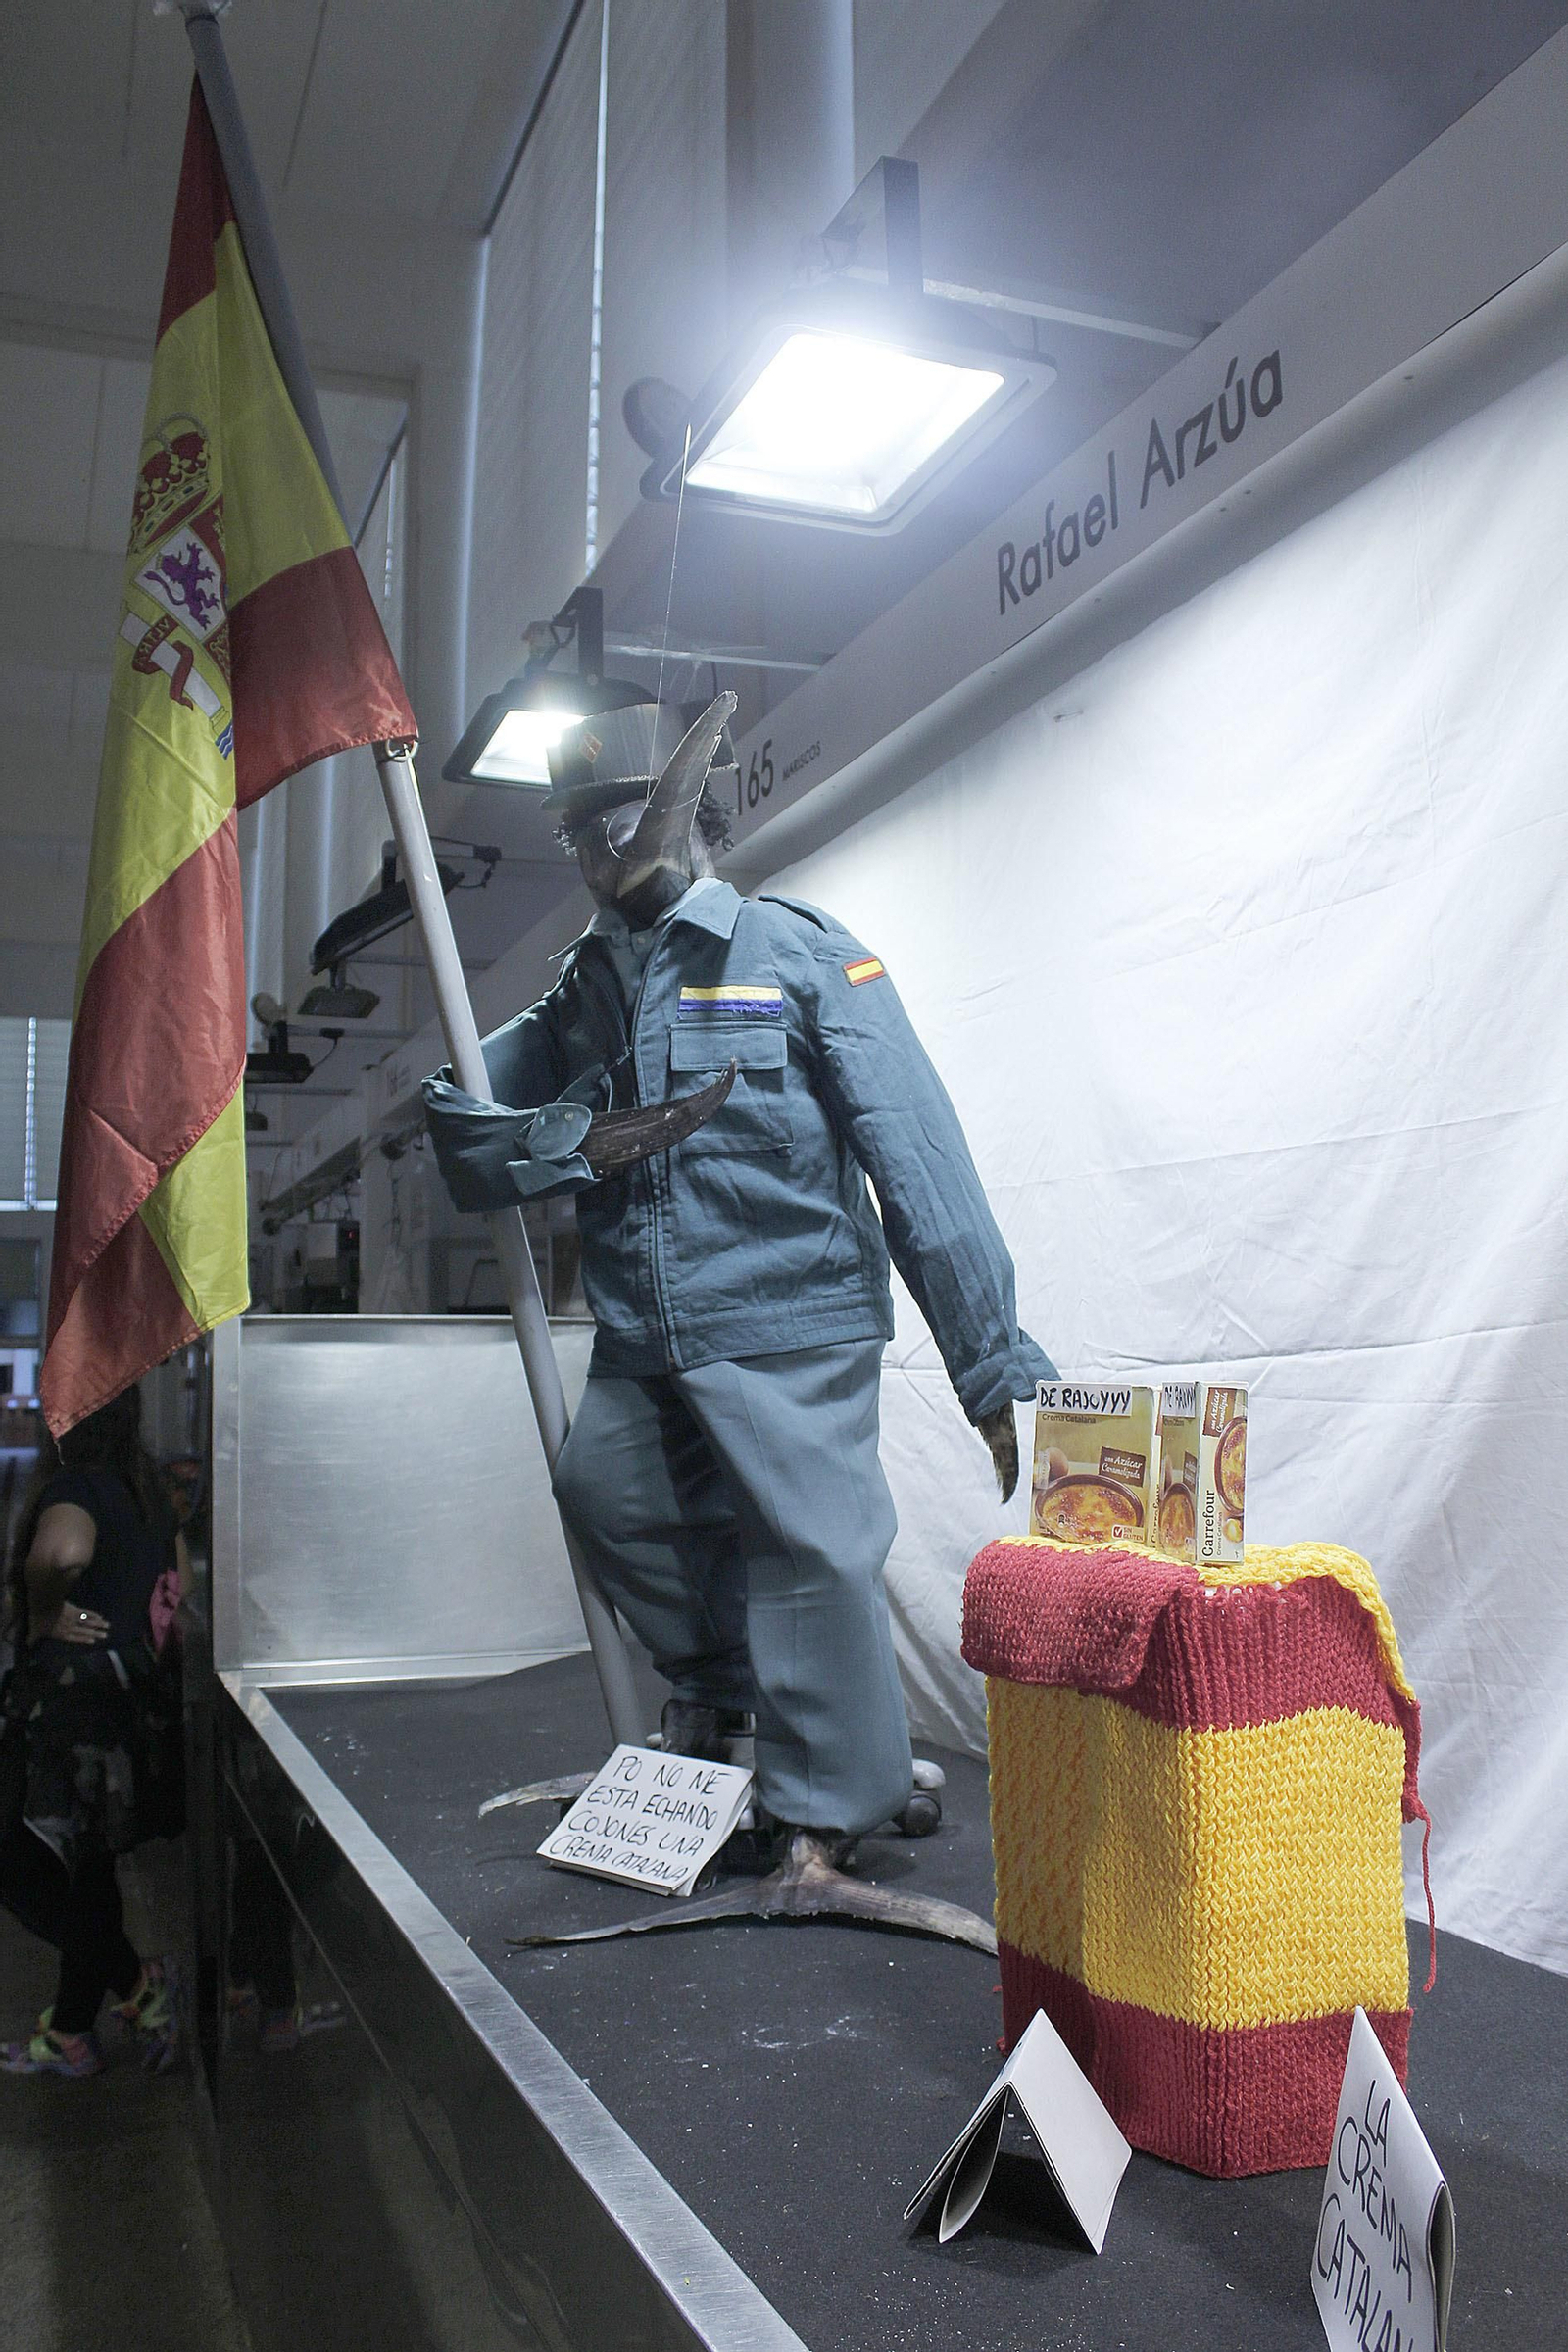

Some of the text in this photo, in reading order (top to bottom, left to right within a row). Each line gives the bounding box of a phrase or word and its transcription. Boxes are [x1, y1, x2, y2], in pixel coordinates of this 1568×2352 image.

[997, 349, 1283, 615] Rafael Arzúa
[735, 738, 774, 816] 165
[1041, 1386, 1131, 1414] DE RAJOYYY
[1065, 1415, 1097, 1424] Catalana
[1201, 1490, 1215, 1557] Carrefour
[613, 1755, 642, 1781] PO
[653, 1764, 683, 1787] NO
[587, 1785, 719, 1831] ESTA ECHANDO
[568, 1810, 705, 1858] COJONES UNA
[612, 1850, 689, 1882] CATALANA
[1364, 2079, 1391, 2168] LA
[1338, 2115, 1413, 2304] CREMA
